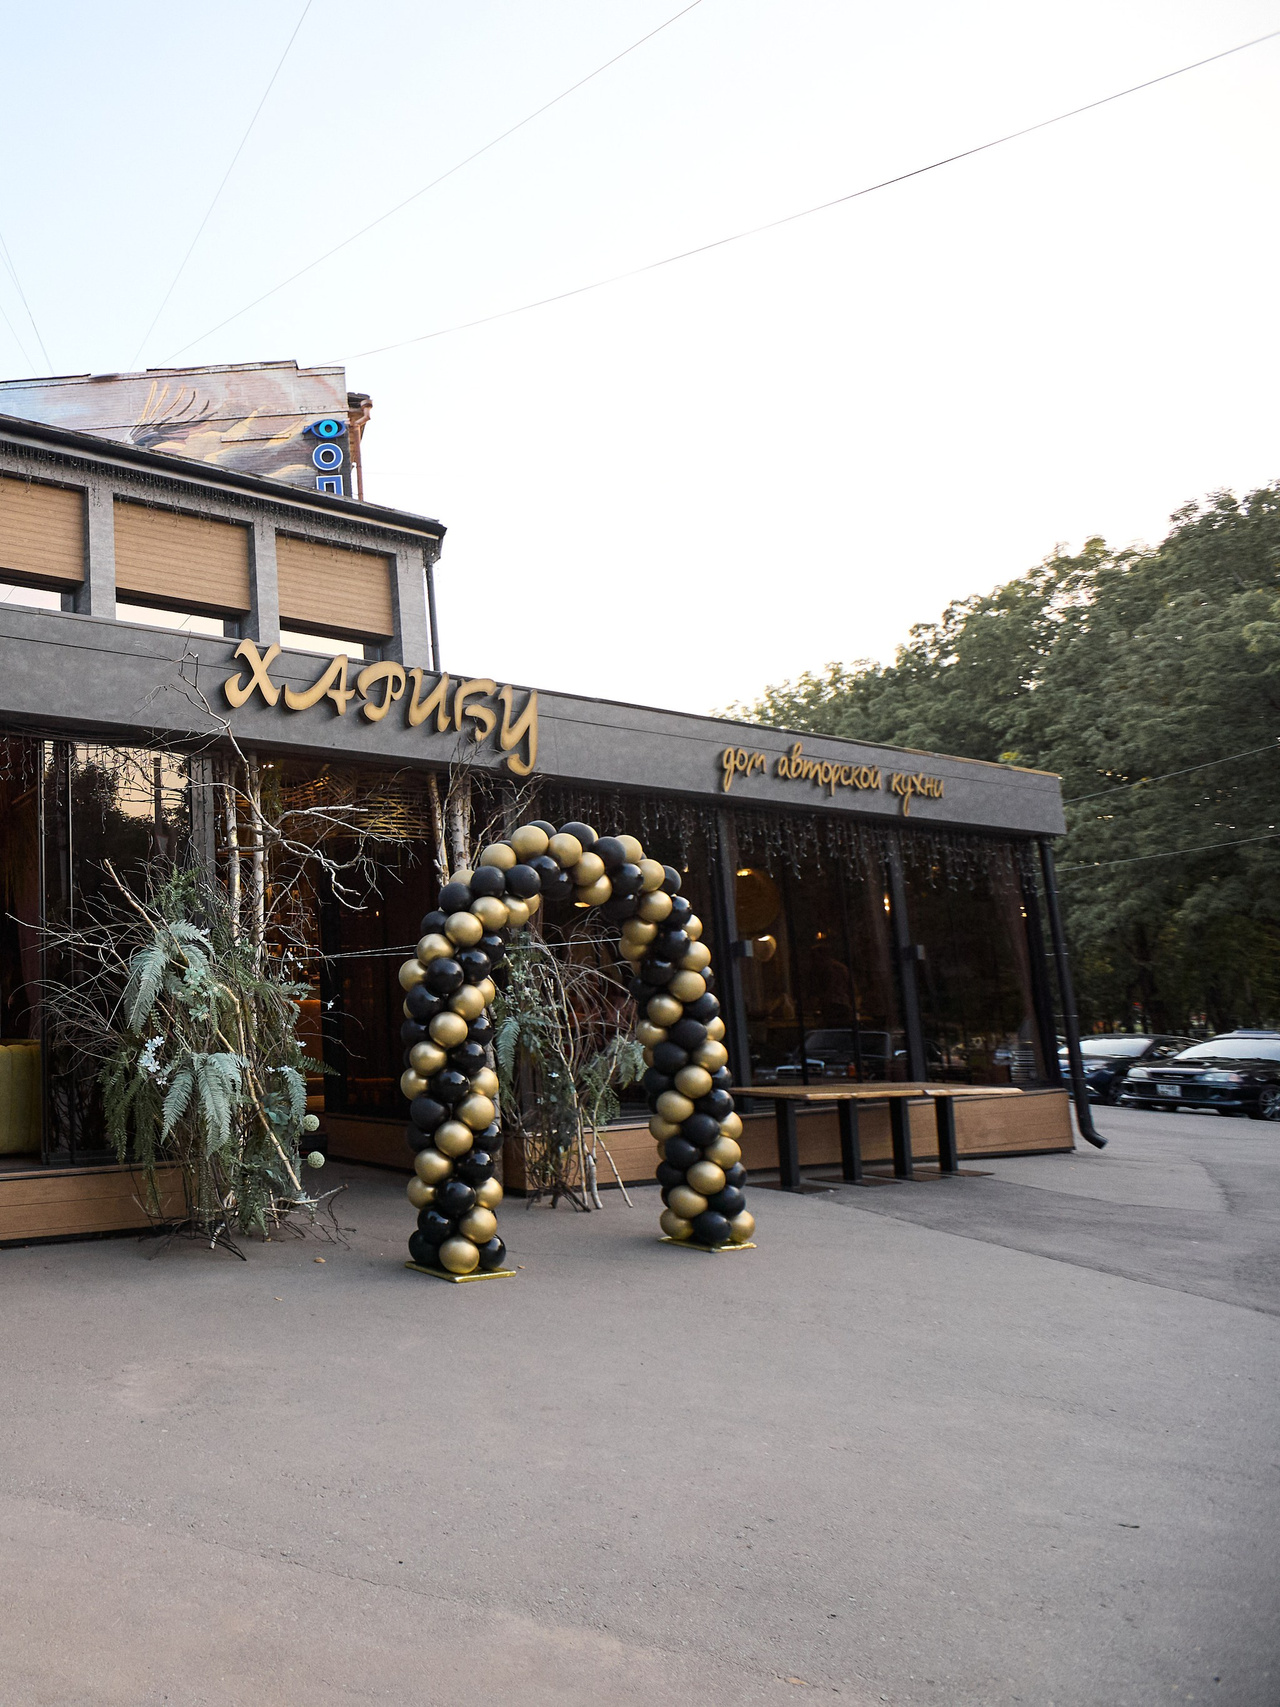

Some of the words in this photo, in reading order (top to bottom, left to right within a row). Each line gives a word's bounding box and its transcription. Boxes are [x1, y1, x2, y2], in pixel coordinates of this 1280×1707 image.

[223, 638, 538, 777] ХАРИБУ
[722, 747, 767, 792] дом
[777, 742, 882, 796] авторской
[890, 772, 945, 817] кухни
